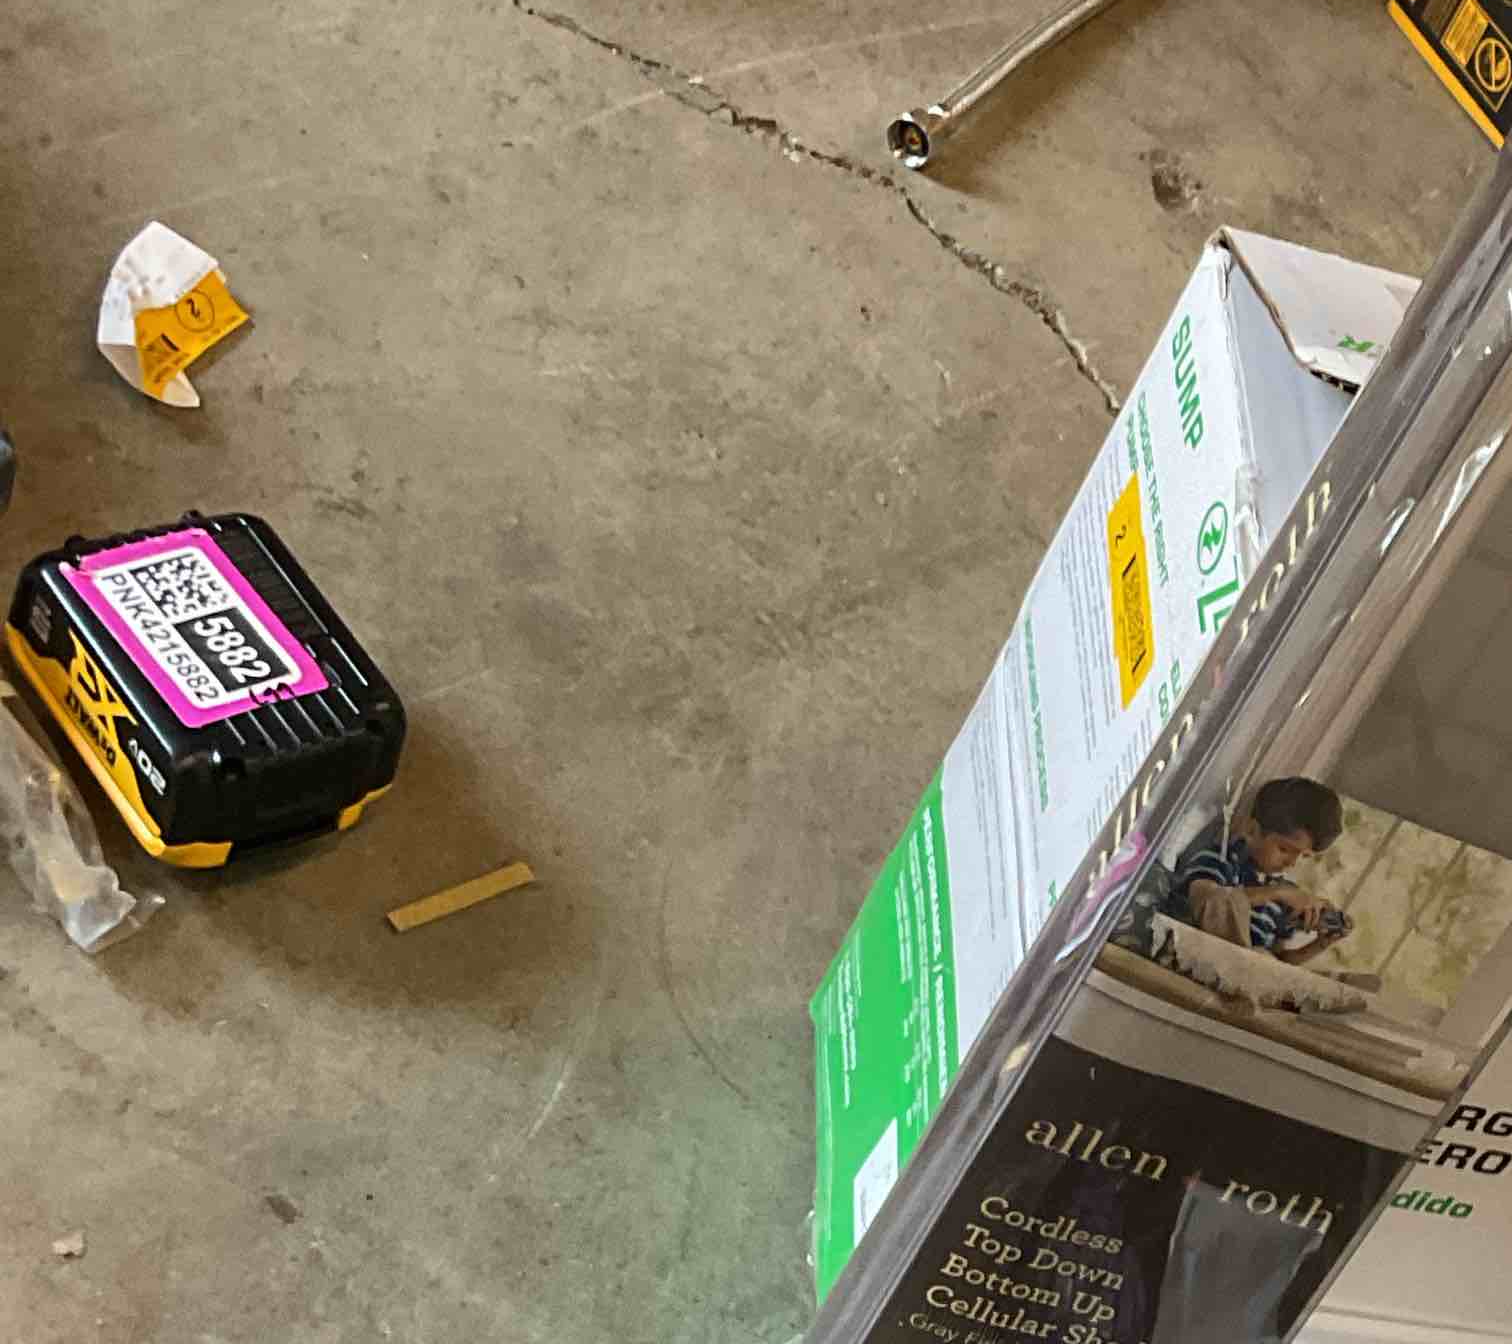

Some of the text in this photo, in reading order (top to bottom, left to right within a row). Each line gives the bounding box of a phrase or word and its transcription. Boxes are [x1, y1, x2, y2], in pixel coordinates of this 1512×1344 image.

[1171, 313, 1204, 449] SUMP
[102, 574, 220, 703] PNK4215882
[193, 616, 271, 684] 5882
[1024, 1118, 1335, 1235] allen roth
[963, 1223, 1124, 1292] Top Down
[979, 1195, 1124, 1255] Cordless
[925, 1285, 1058, 1338] Cellular
[939, 1252, 1116, 1323] Bottom Up
[909, 1312, 960, 1344] Gray
